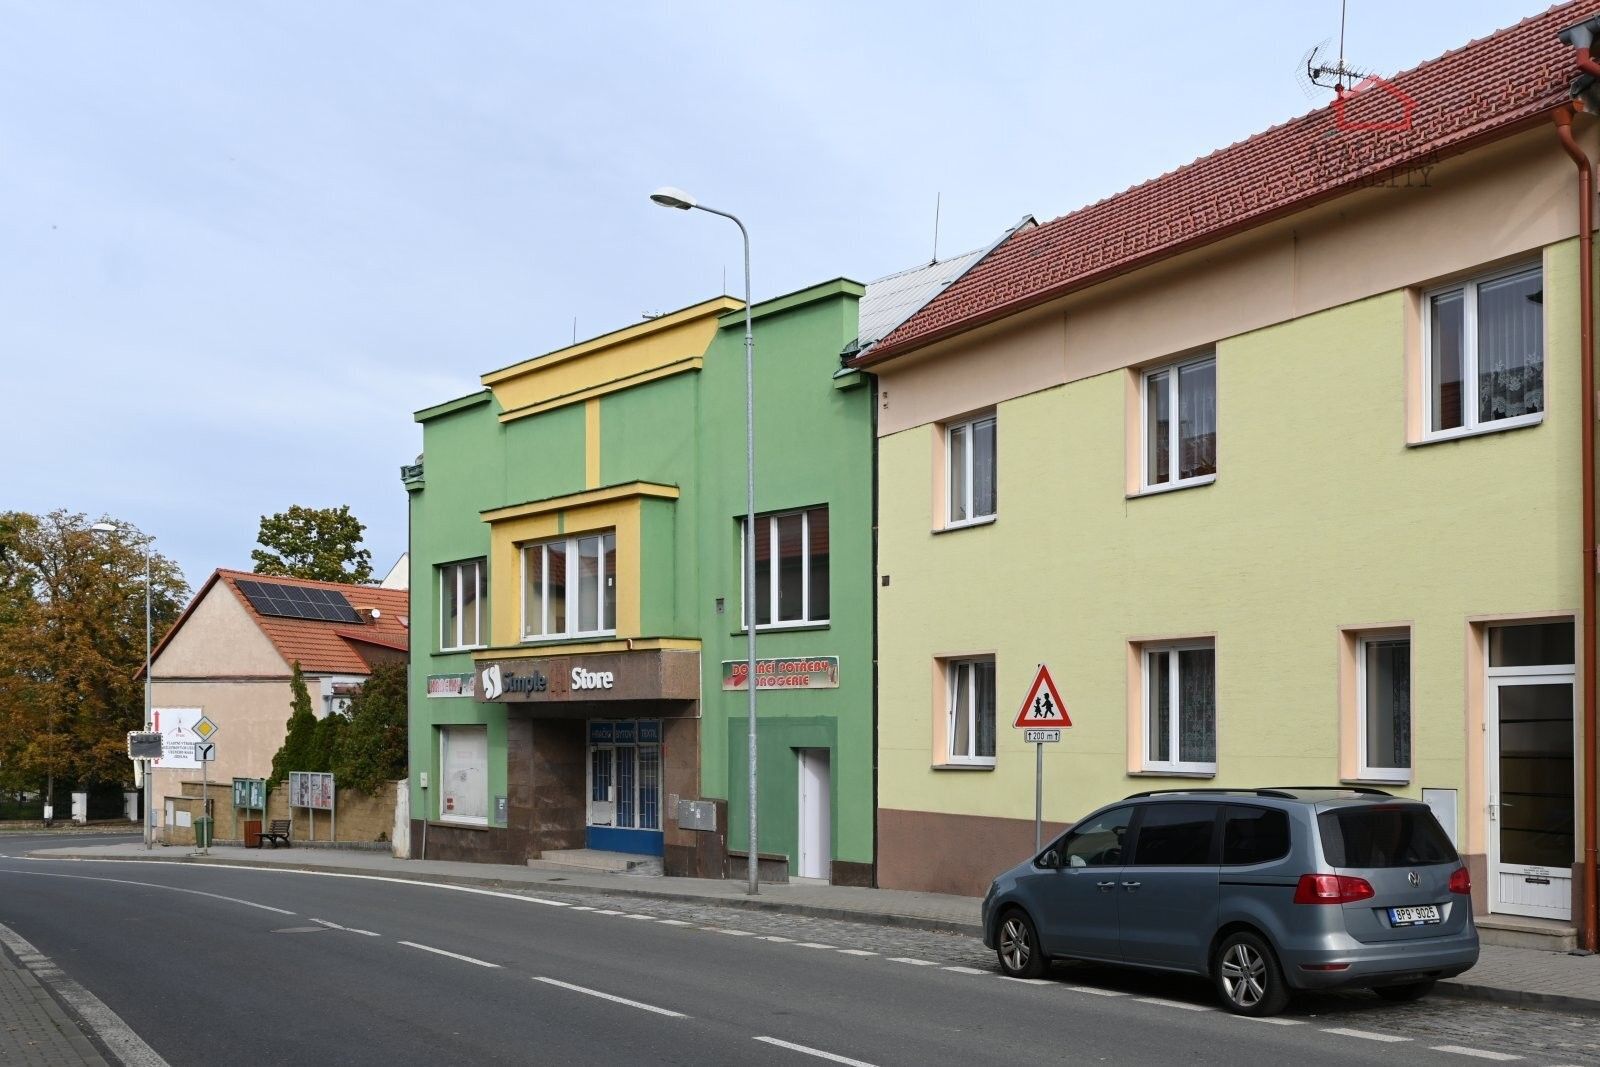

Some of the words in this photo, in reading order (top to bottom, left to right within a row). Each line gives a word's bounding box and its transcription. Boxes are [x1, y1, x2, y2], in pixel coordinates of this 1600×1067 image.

[732, 661, 775, 675] DOÁCÍ
[502, 670, 547, 698] Simple
[571, 667, 614, 690] Store
[641, 728, 657, 738] TEXTIL
[1396, 909, 1412, 920] 8P9
[1416, 907, 1435, 918] 9025
